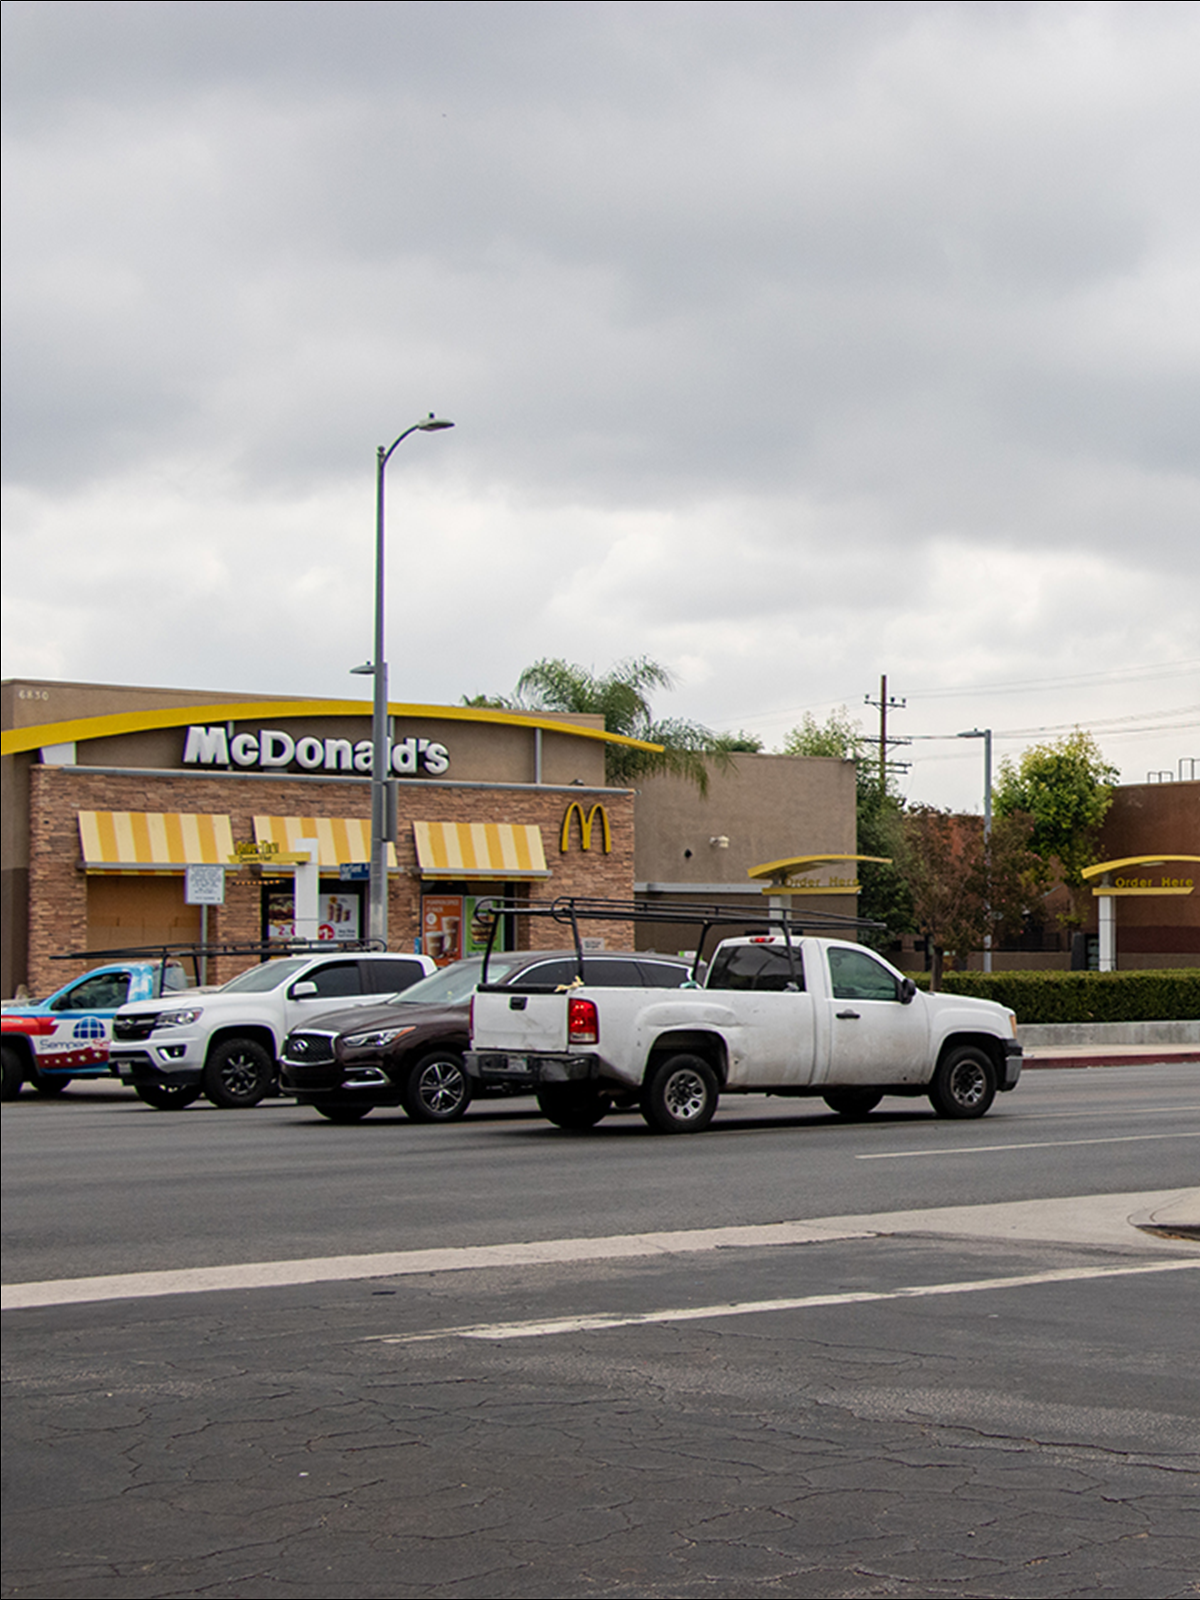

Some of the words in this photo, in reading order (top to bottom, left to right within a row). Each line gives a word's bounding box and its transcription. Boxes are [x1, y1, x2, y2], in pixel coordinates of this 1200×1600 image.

[18, 689, 49, 701] 6830
[784, 875, 821, 888] Order
[829, 876, 860, 887] Here
[1115, 876, 1153, 888] Order
[1161, 876, 1194, 888] Here
[40, 1038, 89, 1050] Semper
